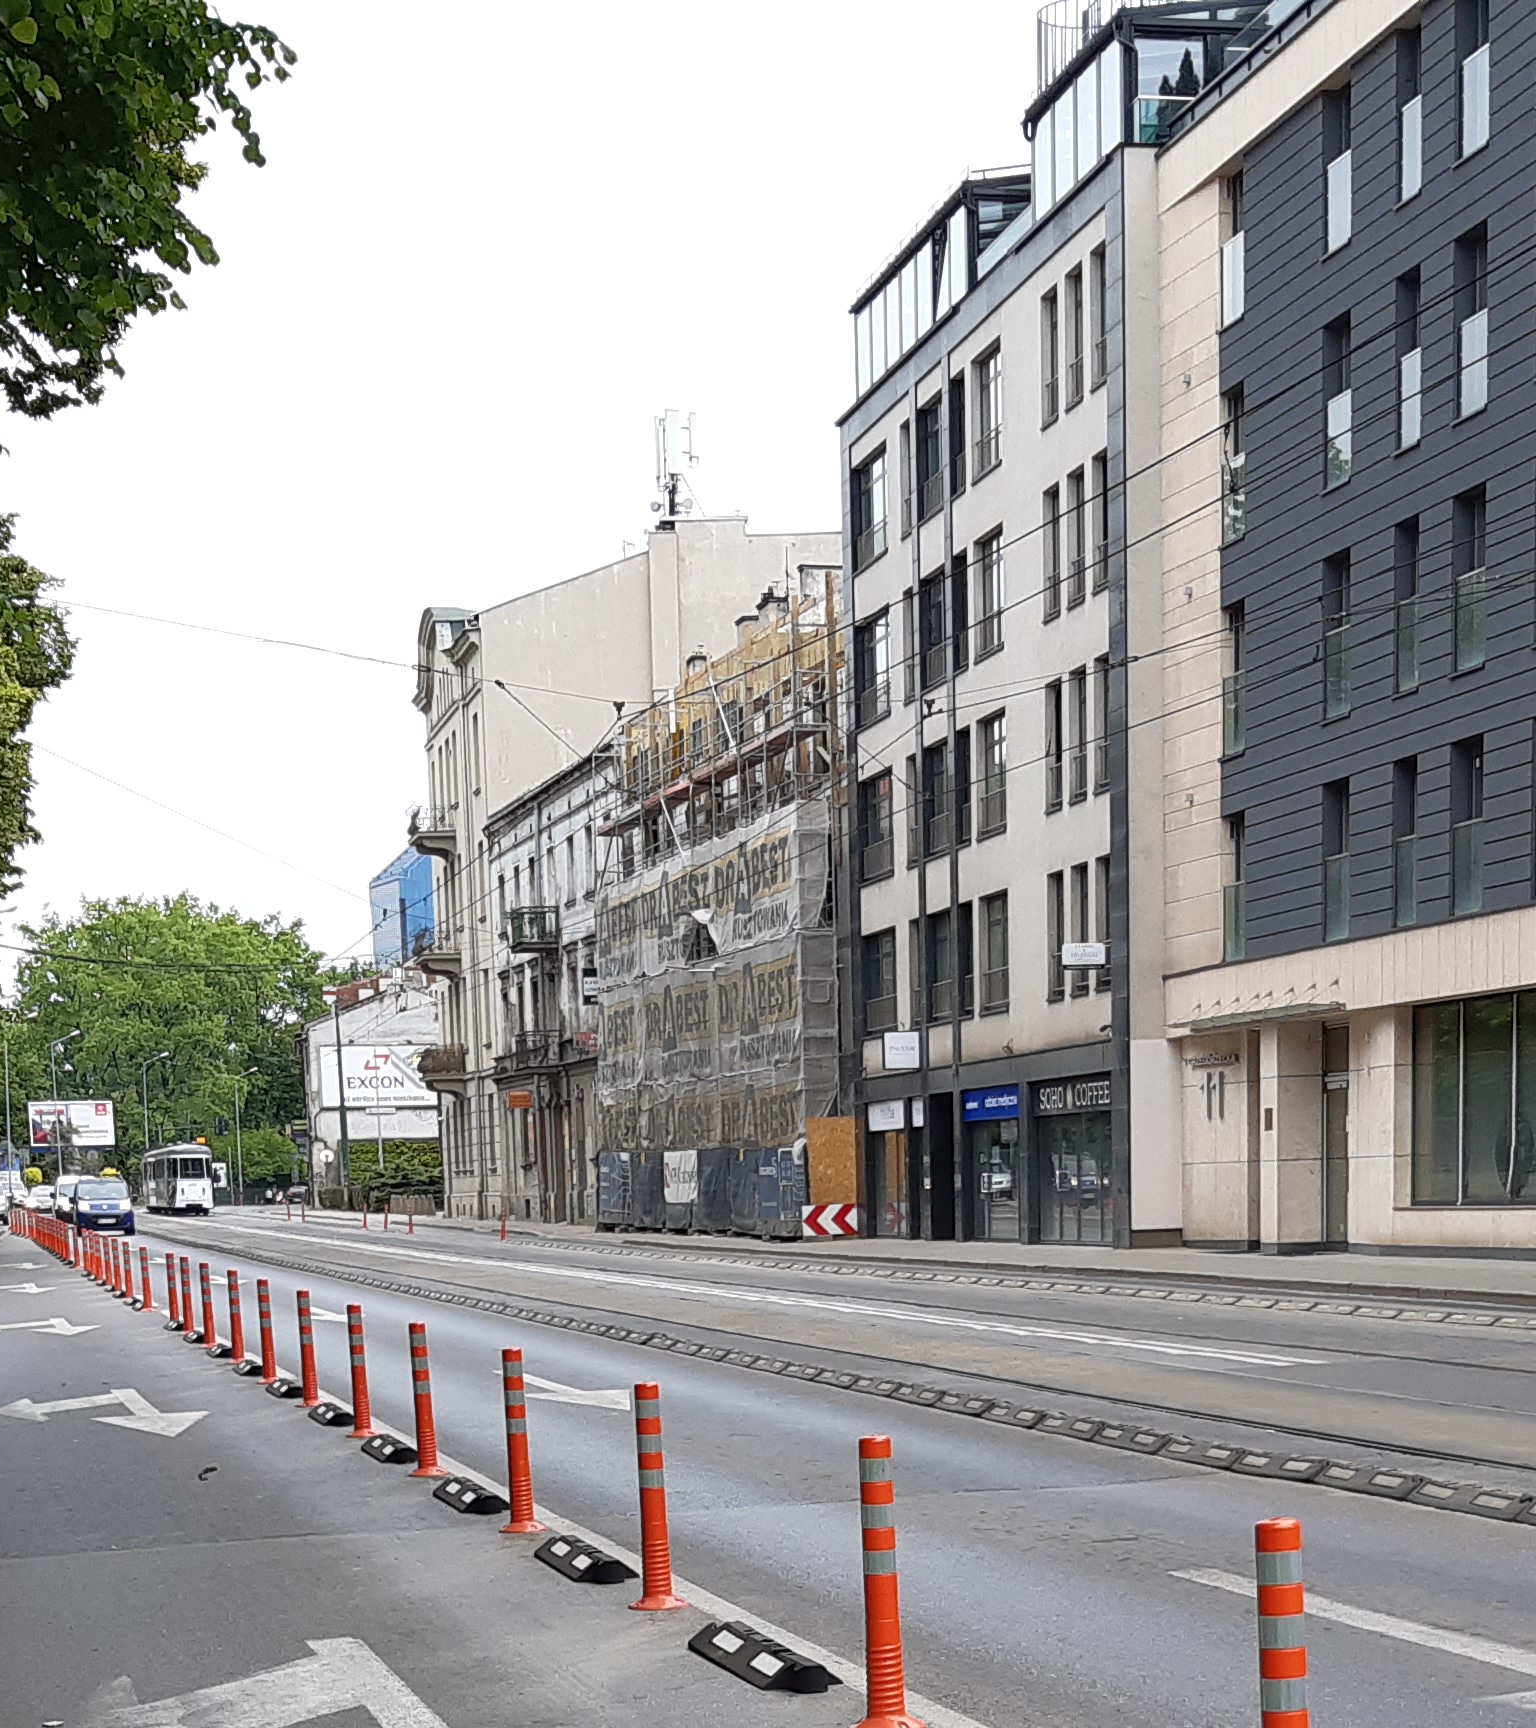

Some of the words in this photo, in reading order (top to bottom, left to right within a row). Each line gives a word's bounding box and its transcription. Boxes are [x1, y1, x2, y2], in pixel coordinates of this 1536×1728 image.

[346, 1075, 405, 1090] EXCON
[1039, 1086, 1064, 1110] SOHO
[1074, 1080, 1111, 1107] COFFEE
